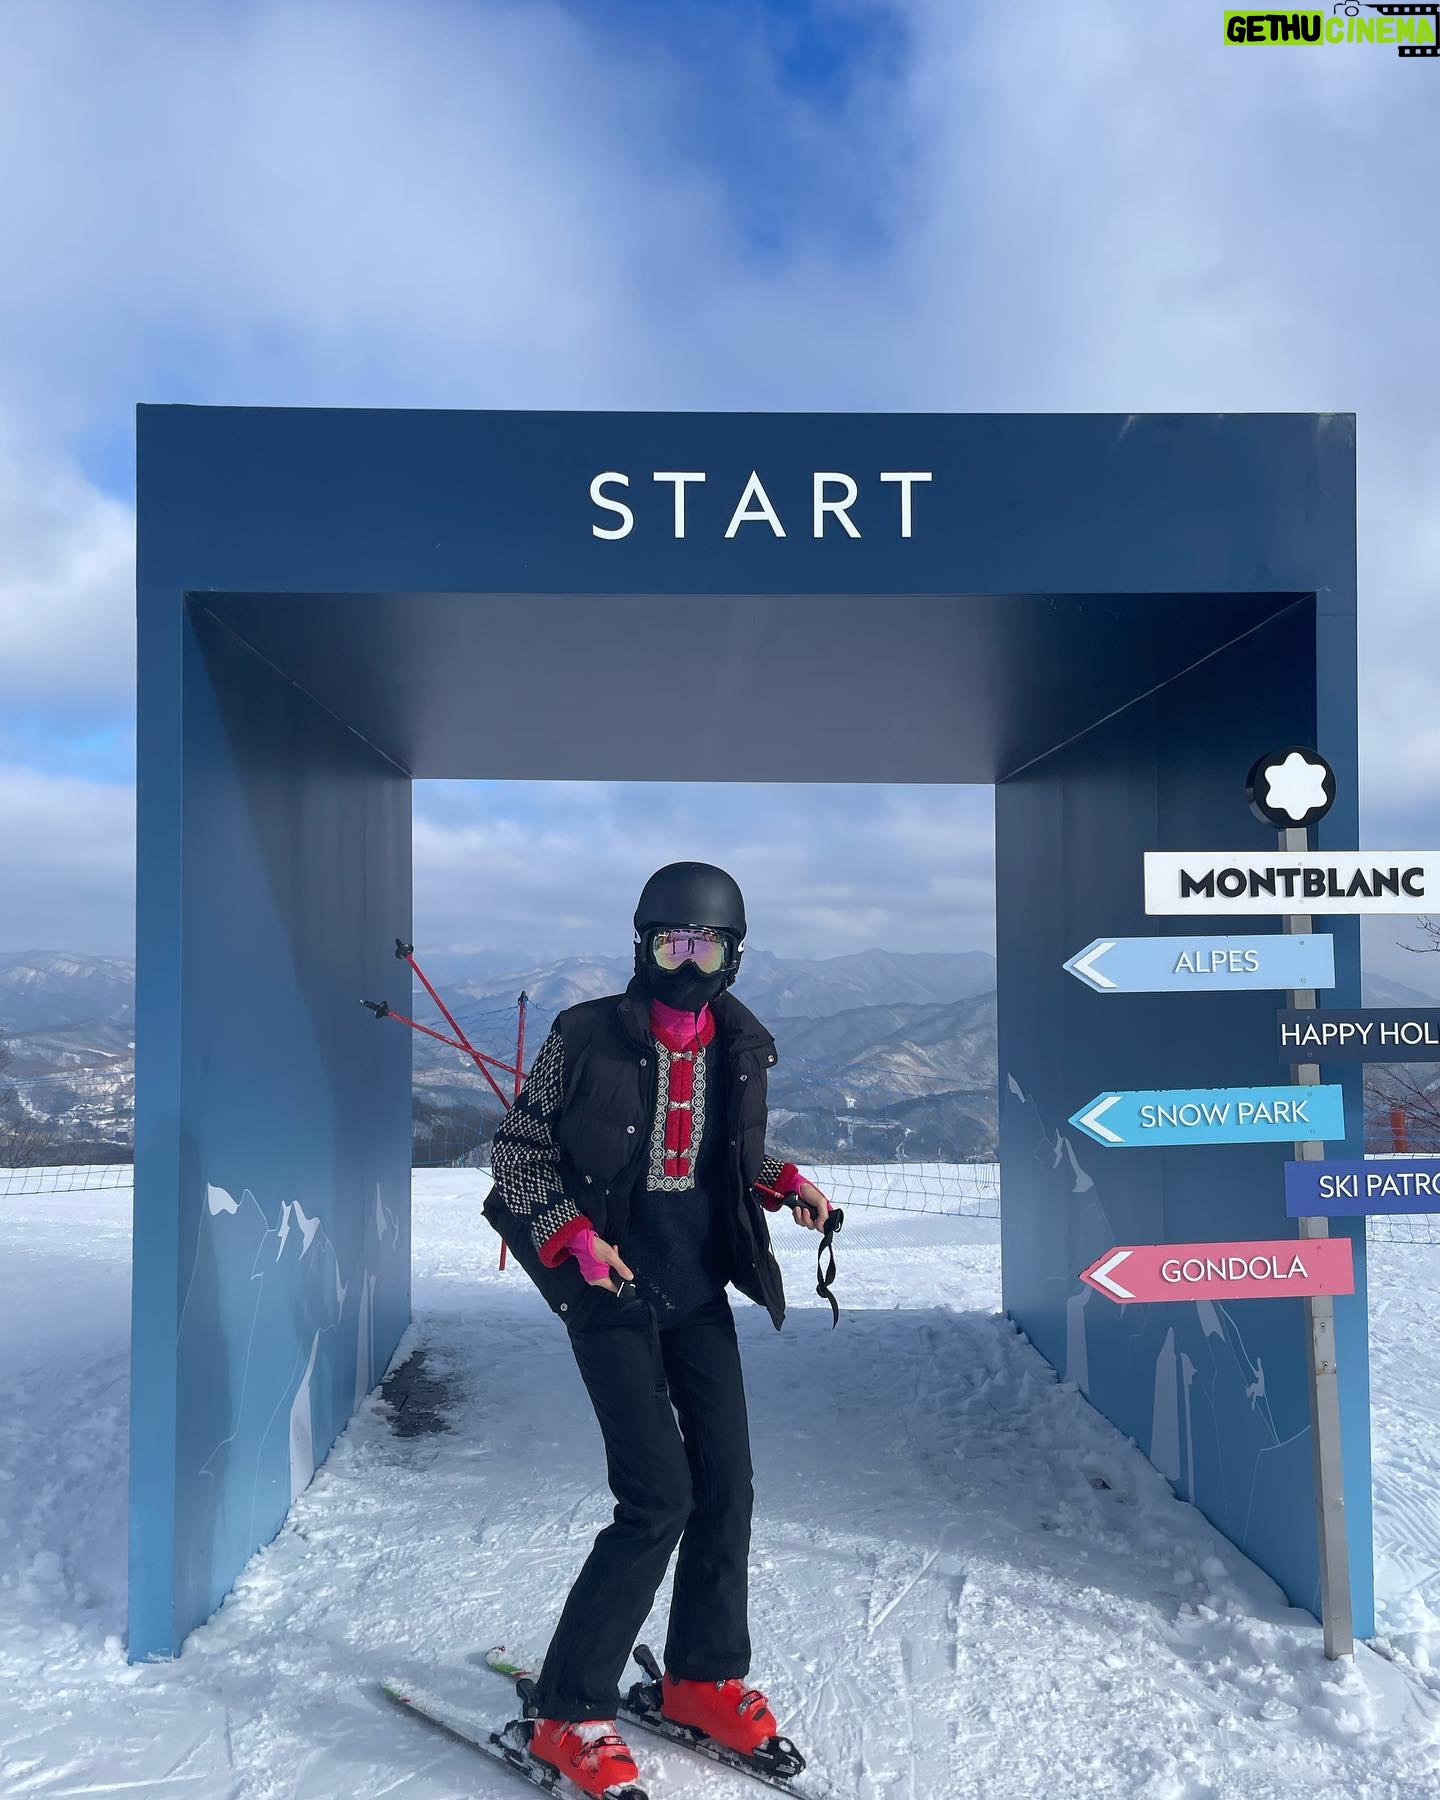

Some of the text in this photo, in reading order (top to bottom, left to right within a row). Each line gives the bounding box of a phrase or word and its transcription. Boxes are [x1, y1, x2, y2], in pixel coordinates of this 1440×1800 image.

[589, 470, 933, 540] START
[1180, 867, 1425, 898] MONTBLANC
[1174, 949, 1259, 974] ALPES
[1281, 1022, 1374, 1046] HAPPY
[1140, 1100, 1310, 1128] SNOW PARK
[1319, 1174, 1359, 1199] SKI
[1160, 1255, 1309, 1284] GONDOLA
